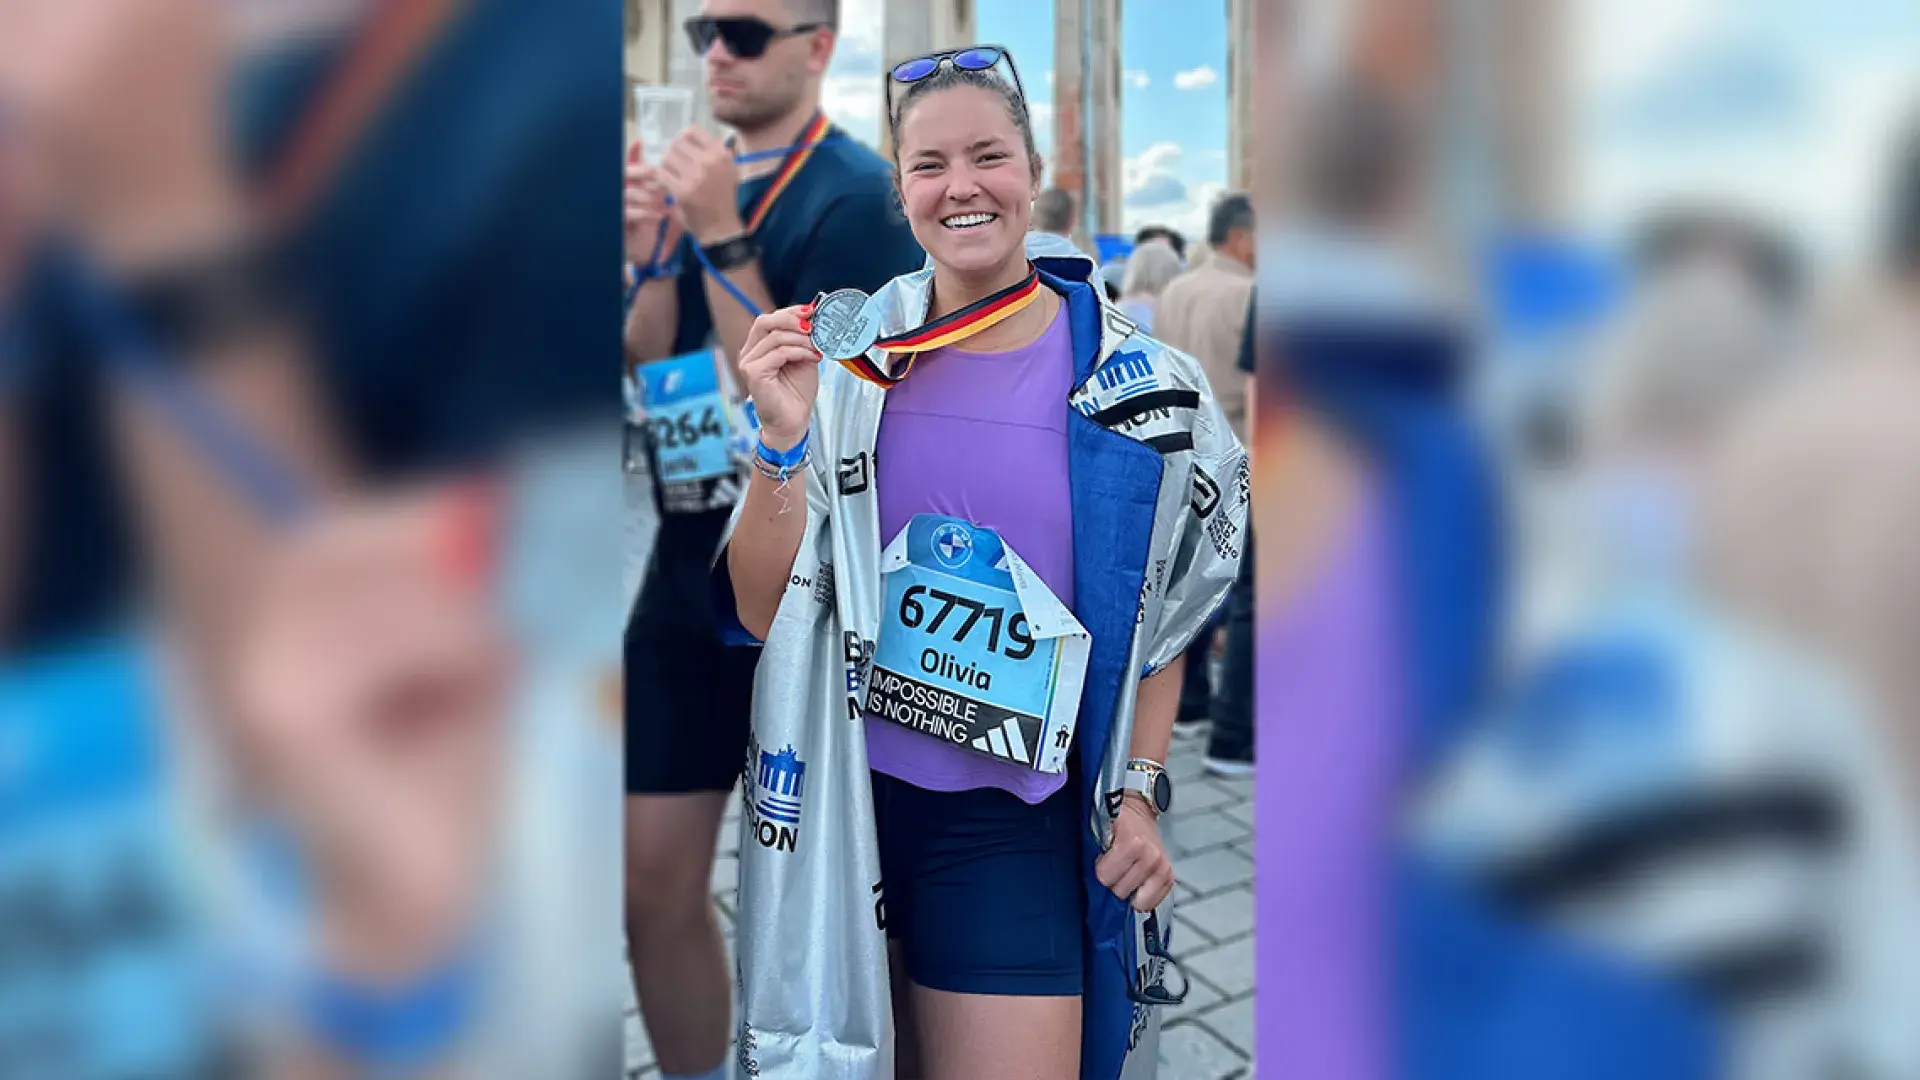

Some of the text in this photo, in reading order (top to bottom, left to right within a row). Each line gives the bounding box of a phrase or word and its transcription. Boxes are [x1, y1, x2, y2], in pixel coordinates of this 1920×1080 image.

[647, 405, 722, 448] 264
[899, 585, 1035, 660] 67719
[920, 648, 991, 691] Olivia
[868, 691, 882, 714] IS
[884, 698, 968, 744] NOTHING
[872, 669, 979, 724] IMPOSSIBLE
